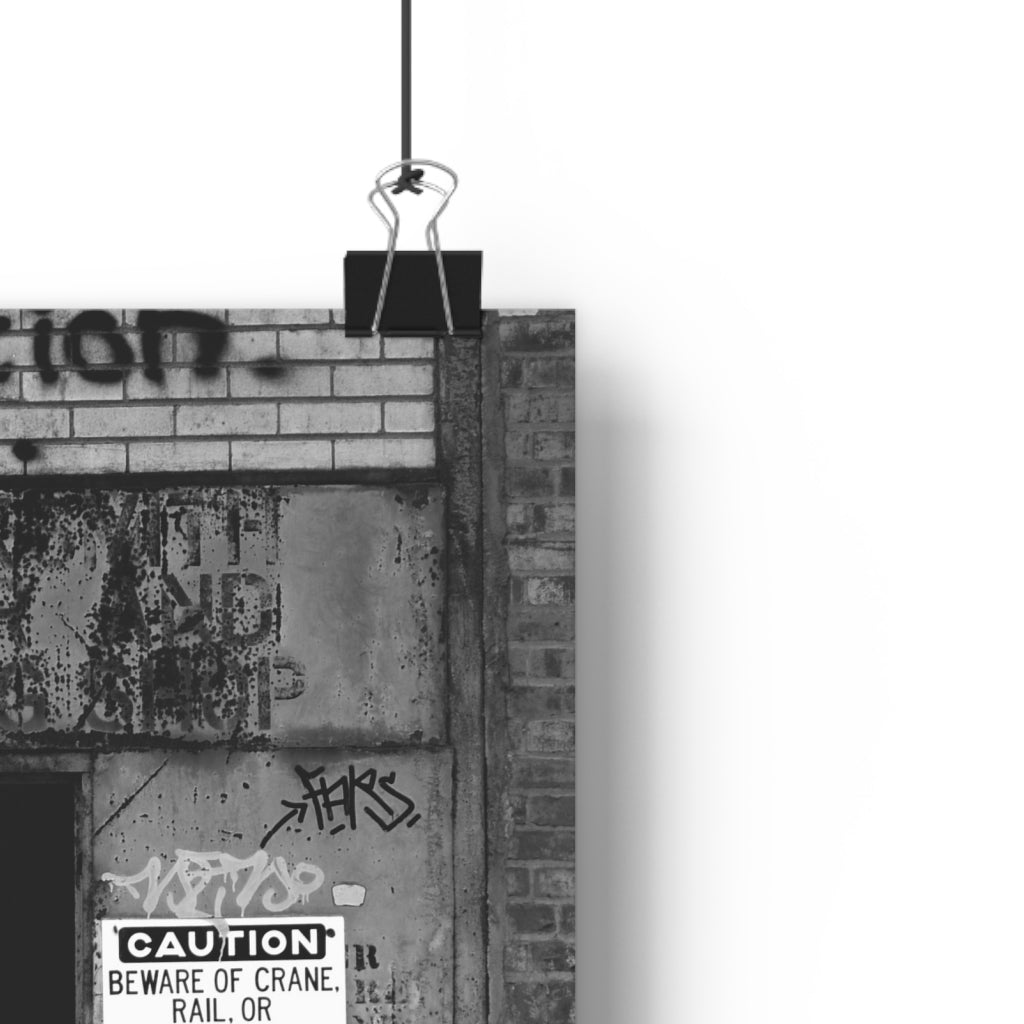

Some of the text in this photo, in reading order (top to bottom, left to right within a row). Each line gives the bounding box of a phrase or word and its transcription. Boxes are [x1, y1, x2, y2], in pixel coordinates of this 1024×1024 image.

[126, 928, 319, 959] CAUTION
[108, 968, 205, 996] BEWARE
[213, 967, 244, 994] OF
[254, 965, 340, 993] CRANE,
[171, 996, 273, 1024] RAIL, OR
